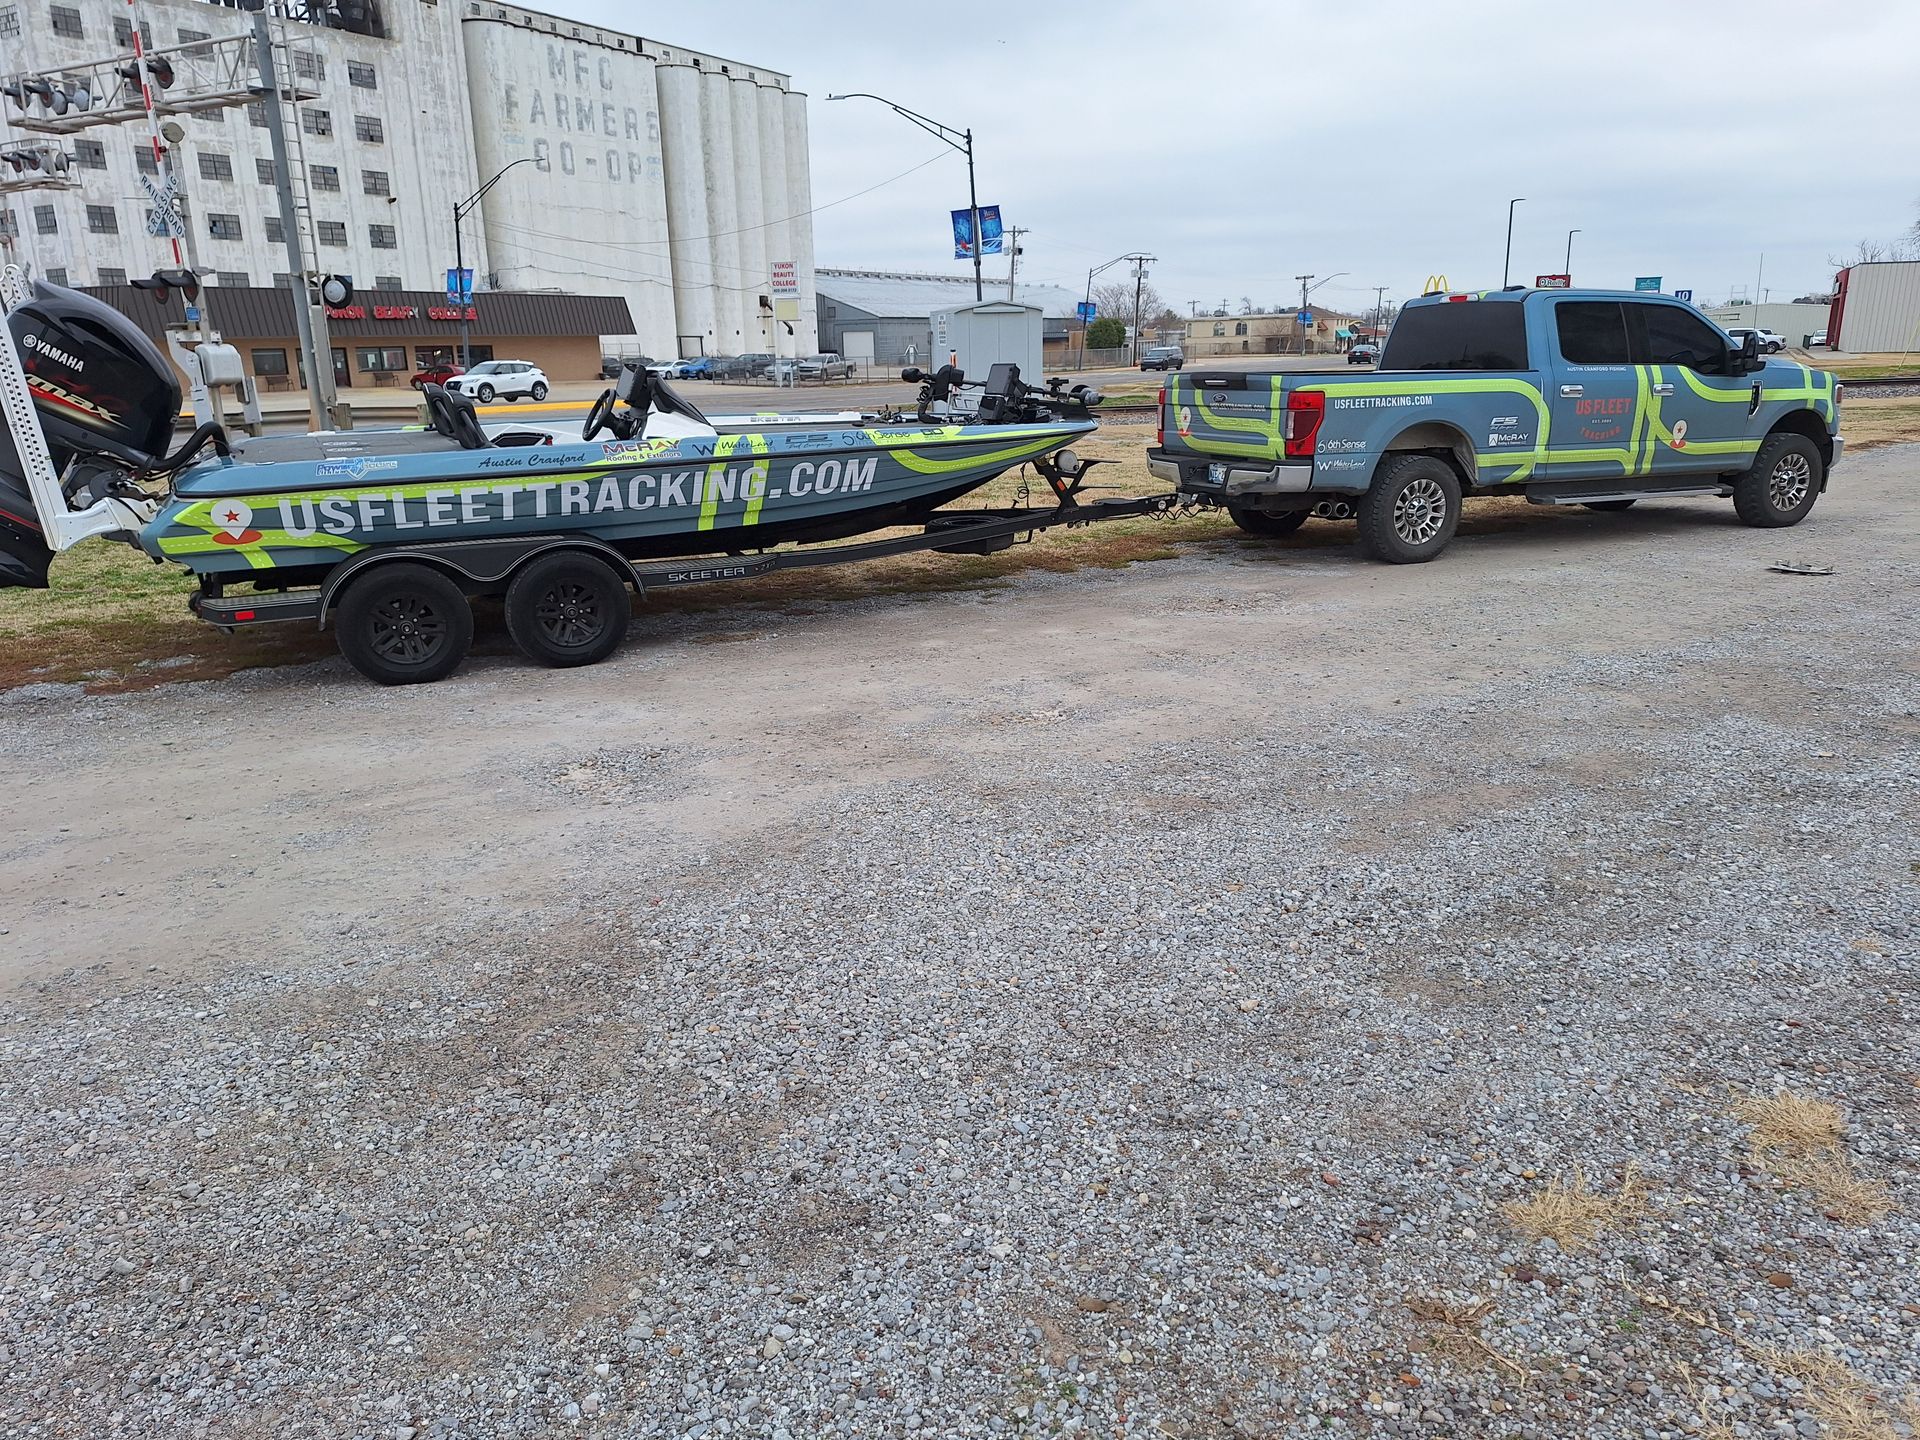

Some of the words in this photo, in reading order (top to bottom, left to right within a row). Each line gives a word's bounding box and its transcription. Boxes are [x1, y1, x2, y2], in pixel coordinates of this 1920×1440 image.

[147, 175, 177, 234] CROSSING
[35, 339, 85, 373] YAMAHA
[1334, 396, 1433, 409] USFLEETTRACKING.COM
[1575, 399, 1592, 415] US
[1593, 398, 1632, 415] FLEET
[874, 429, 911, 439] Sense
[1328, 439, 1340, 449] 6th
[1341, 439, 1367, 449] Sense
[478, 456, 523, 468] Austin
[528, 453, 586, 467] Cranford
[606, 454, 638, 463] Roofing
[647, 451, 682, 459] Exteriors
[278, 457, 879, 539] USFLEETTRACKING.COM
[668, 567, 745, 582] SKEETER
